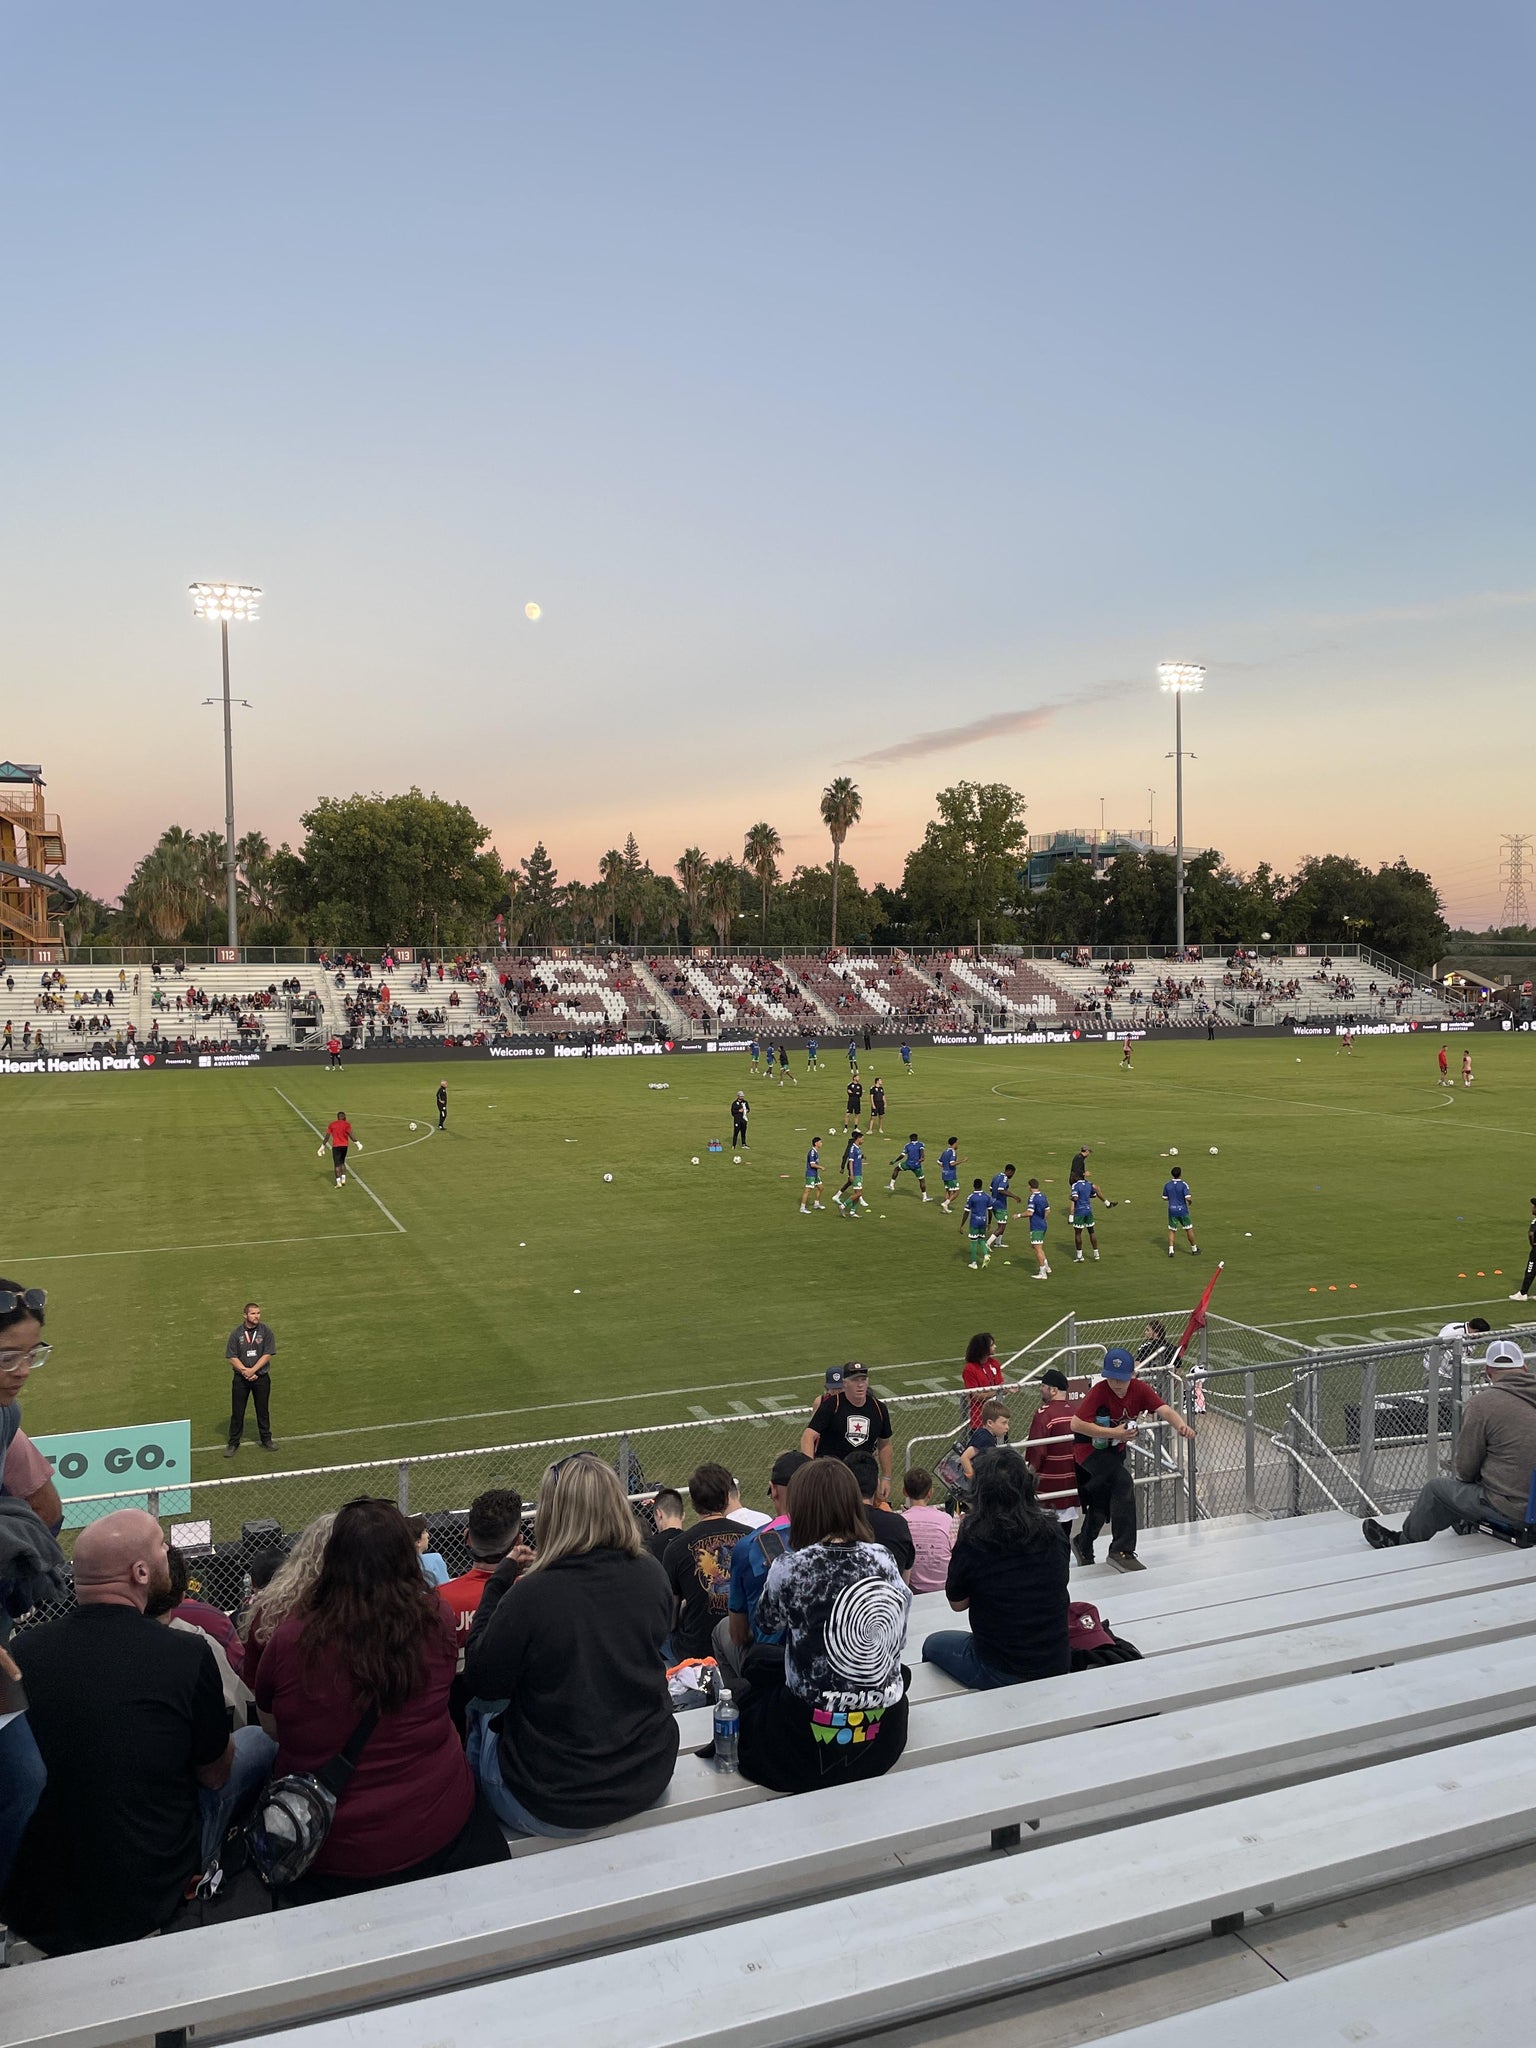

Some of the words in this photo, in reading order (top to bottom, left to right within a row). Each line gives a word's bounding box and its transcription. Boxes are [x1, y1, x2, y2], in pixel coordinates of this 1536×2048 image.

[38, 951, 51, 962] 111
[221, 950, 235, 961] 112
[397, 951, 410, 961] 113
[554, 949, 567, 959] 114
[697, 949, 709, 957] 115
[1293, 1026, 1322, 1035] Welcome
[1323, 1026, 1331, 1035] to
[1361, 1024, 1390, 1034] Health
[1390, 1023, 1410, 1033] Park
[932, 1035, 967, 1044] Welcome
[968, 1035, 977, 1043] to
[984, 1033, 1012, 1044] Heart
[1013, 1032, 1046, 1044] Health
[1047, 1031, 1071, 1043] Park
[490, 1047, 533, 1057] Welcome
[534, 1047, 546, 1056] to
[592, 1042, 633, 1056] Health
[633, 1042, 663, 1055] Park
[213, 1053, 260, 1061] westernhealth
[0, 1058, 46, 1074] Heart
[47, 1057, 101, 1072] Health
[102, 1055, 141, 1070] Park
[104, 1444, 177, 1474] GO.
[812, 1708, 886, 1727] MEOW
[810, 1722, 881, 1745] WOLF
